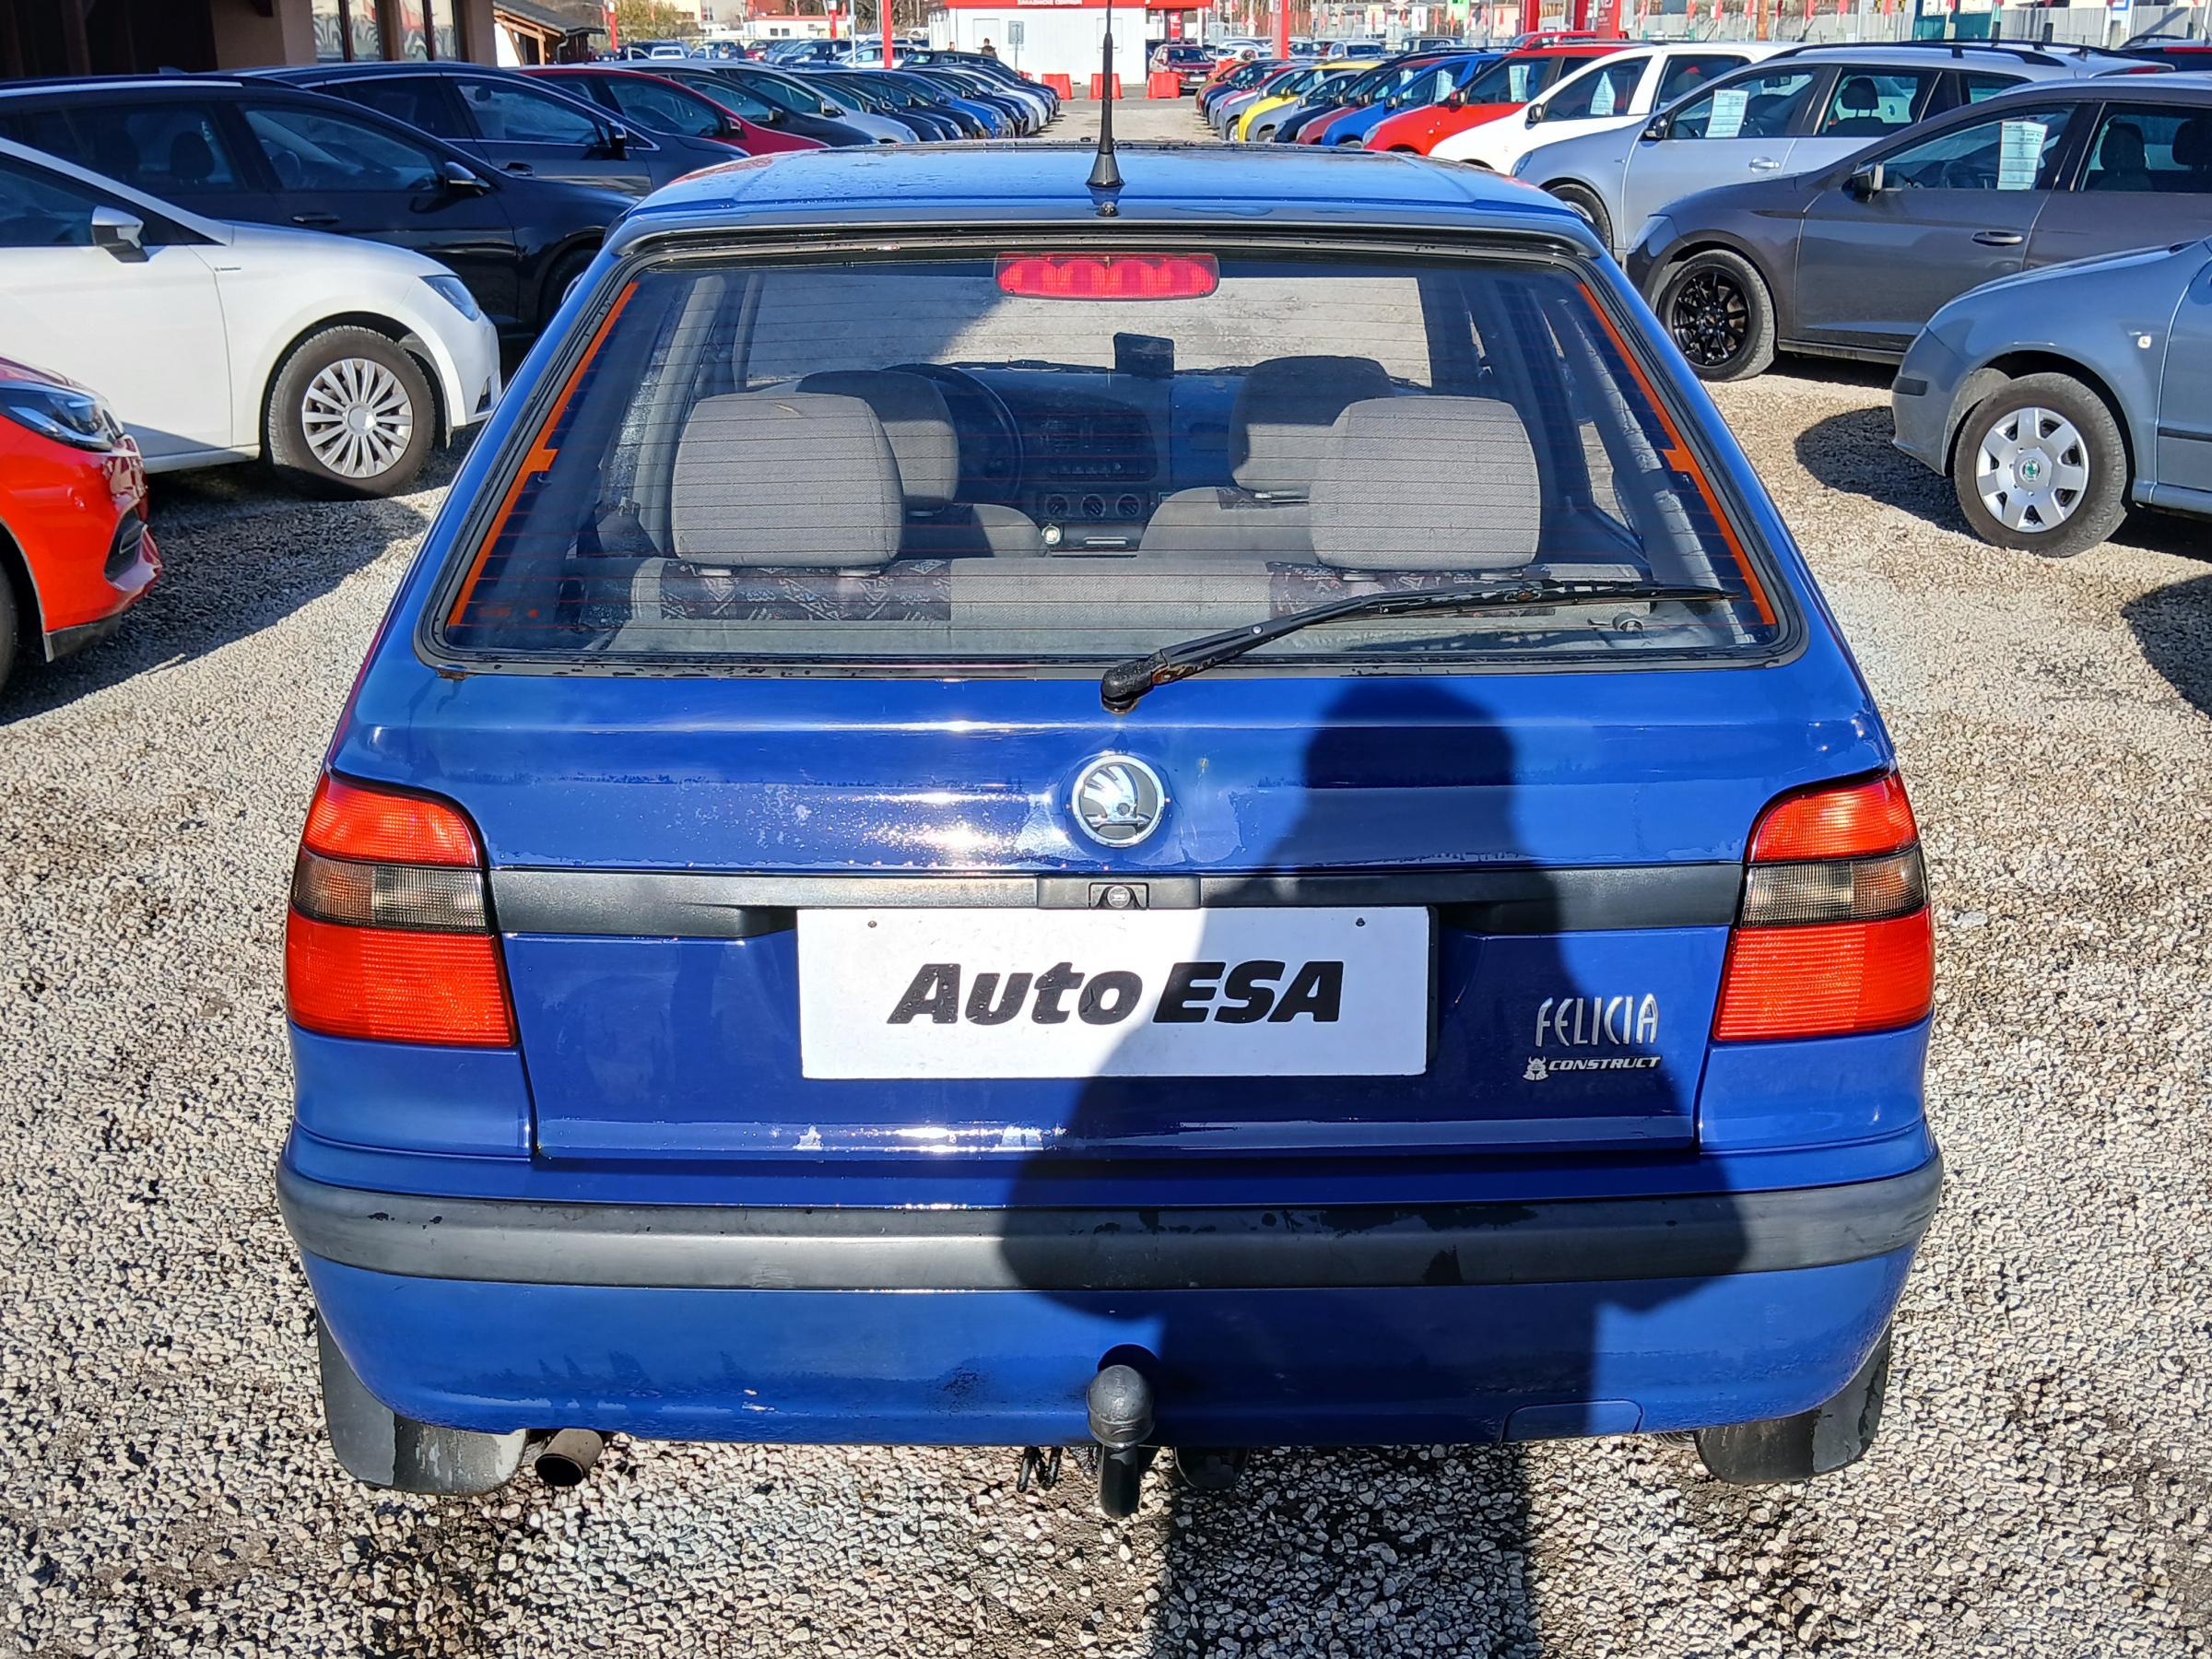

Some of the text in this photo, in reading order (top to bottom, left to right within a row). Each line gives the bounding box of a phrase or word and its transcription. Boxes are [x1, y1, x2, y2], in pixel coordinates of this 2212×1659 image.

[887, 959, 1344, 1026] Auto ESA
[1535, 994, 1659, 1047] FELICIA
[1548, 1056, 1661, 1071] CONSTRUCT
